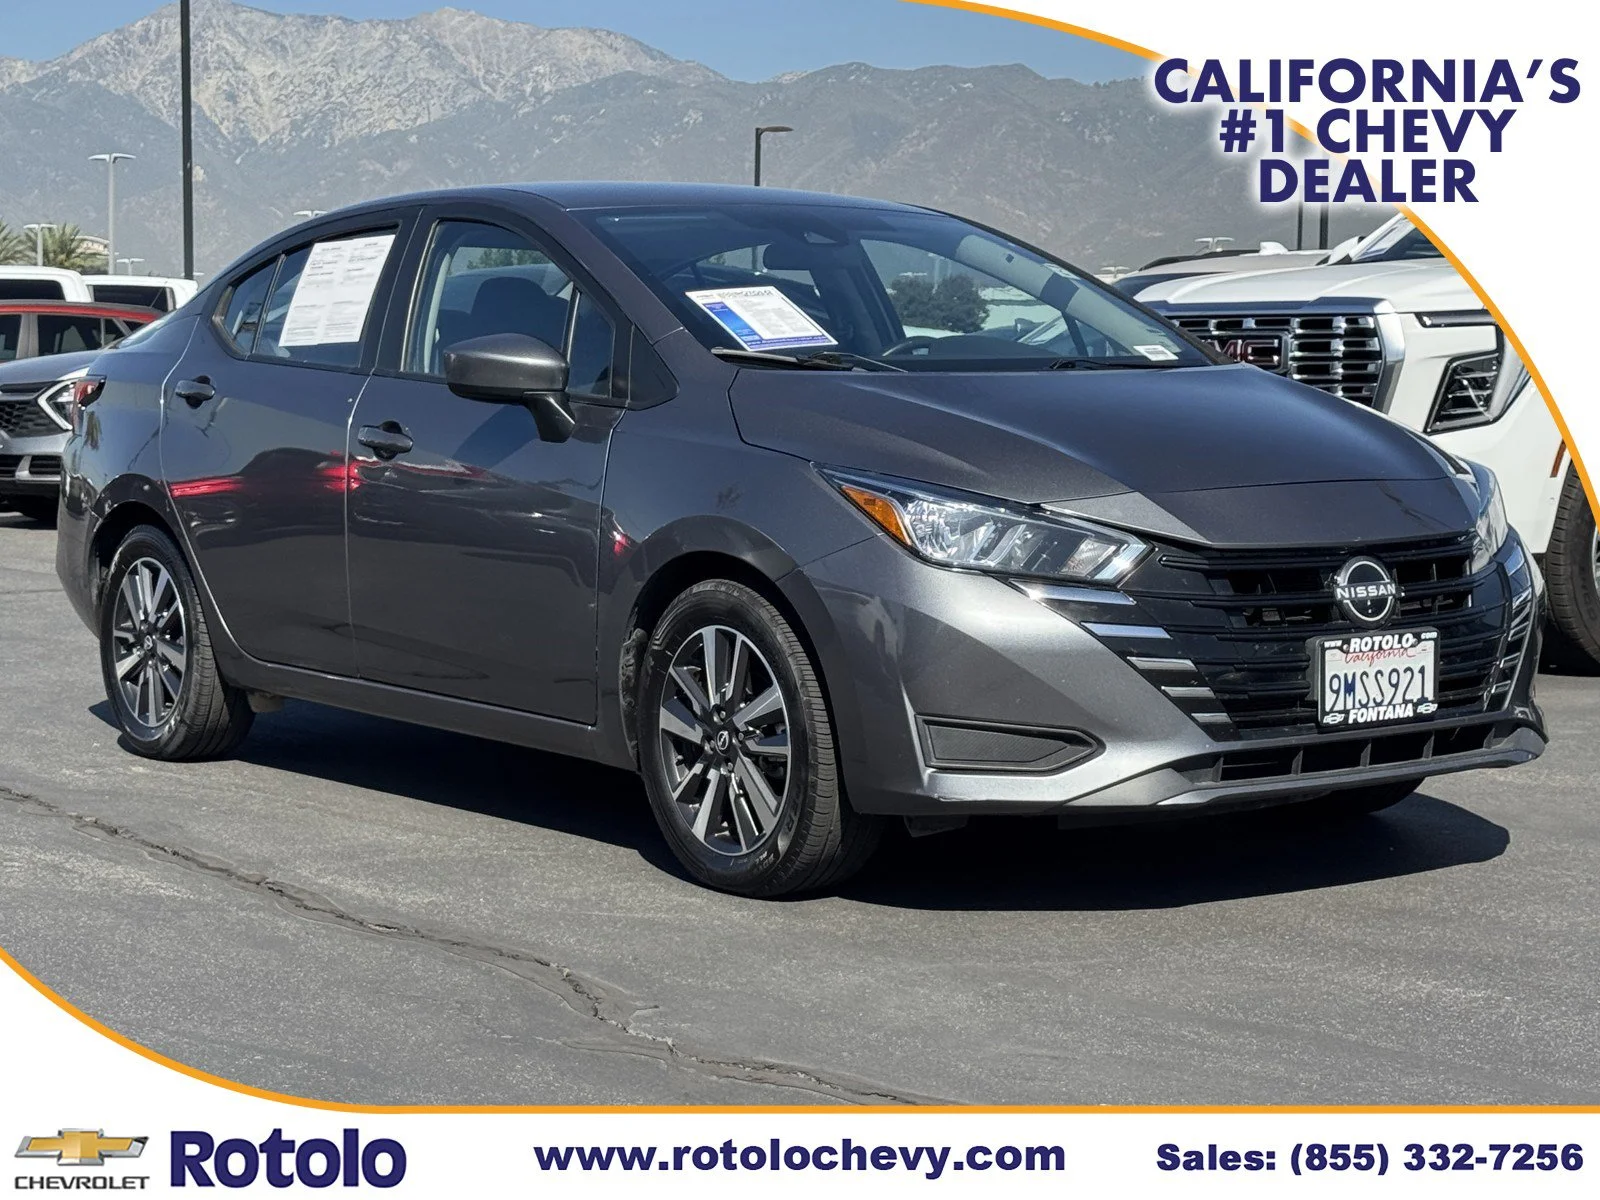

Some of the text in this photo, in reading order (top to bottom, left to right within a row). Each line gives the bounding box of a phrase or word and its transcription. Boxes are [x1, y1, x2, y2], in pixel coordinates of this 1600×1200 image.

[1336, 583, 1396, 600] NISSAN
[1349, 633, 1414, 653] ROTOLO
[1328, 665, 1429, 712] 9MSS921
[1348, 703, 1414, 724] FONTANA
